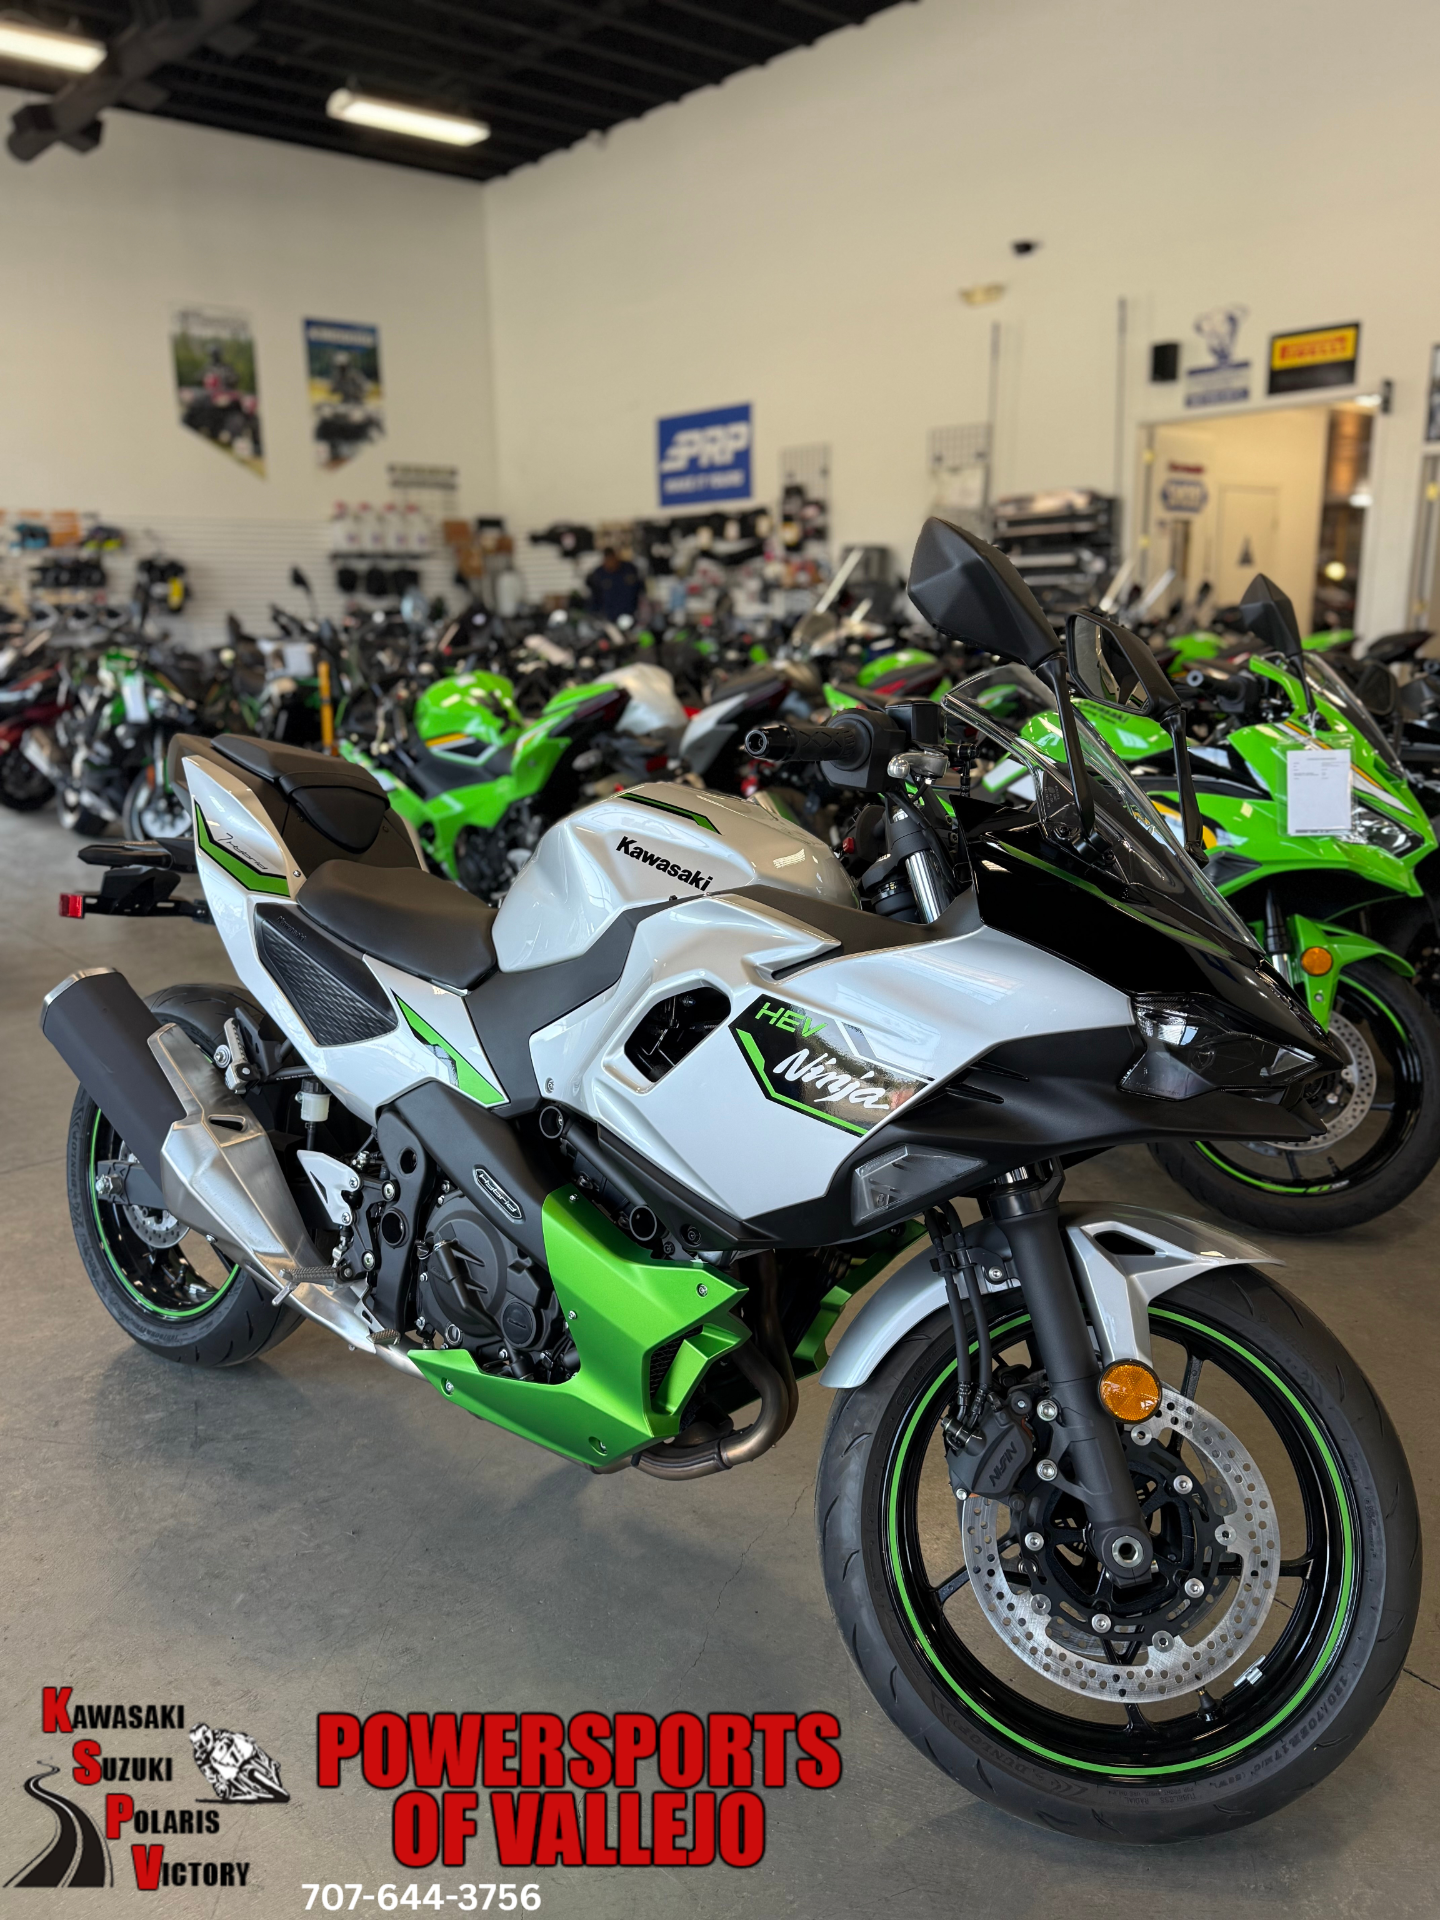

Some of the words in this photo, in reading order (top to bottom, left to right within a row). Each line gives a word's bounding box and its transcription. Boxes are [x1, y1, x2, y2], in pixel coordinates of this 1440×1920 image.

[661, 421, 749, 474] PRP
[616, 835, 714, 892] Kawasaki
[755, 1001, 828, 1038] HEV
[772, 1048, 890, 1110] Ninja
[70, 1129, 79, 1189] DUNLOP
[479, 1174, 517, 1212] Hybrid
[955, 1721, 1029, 1776] DUNLOP
